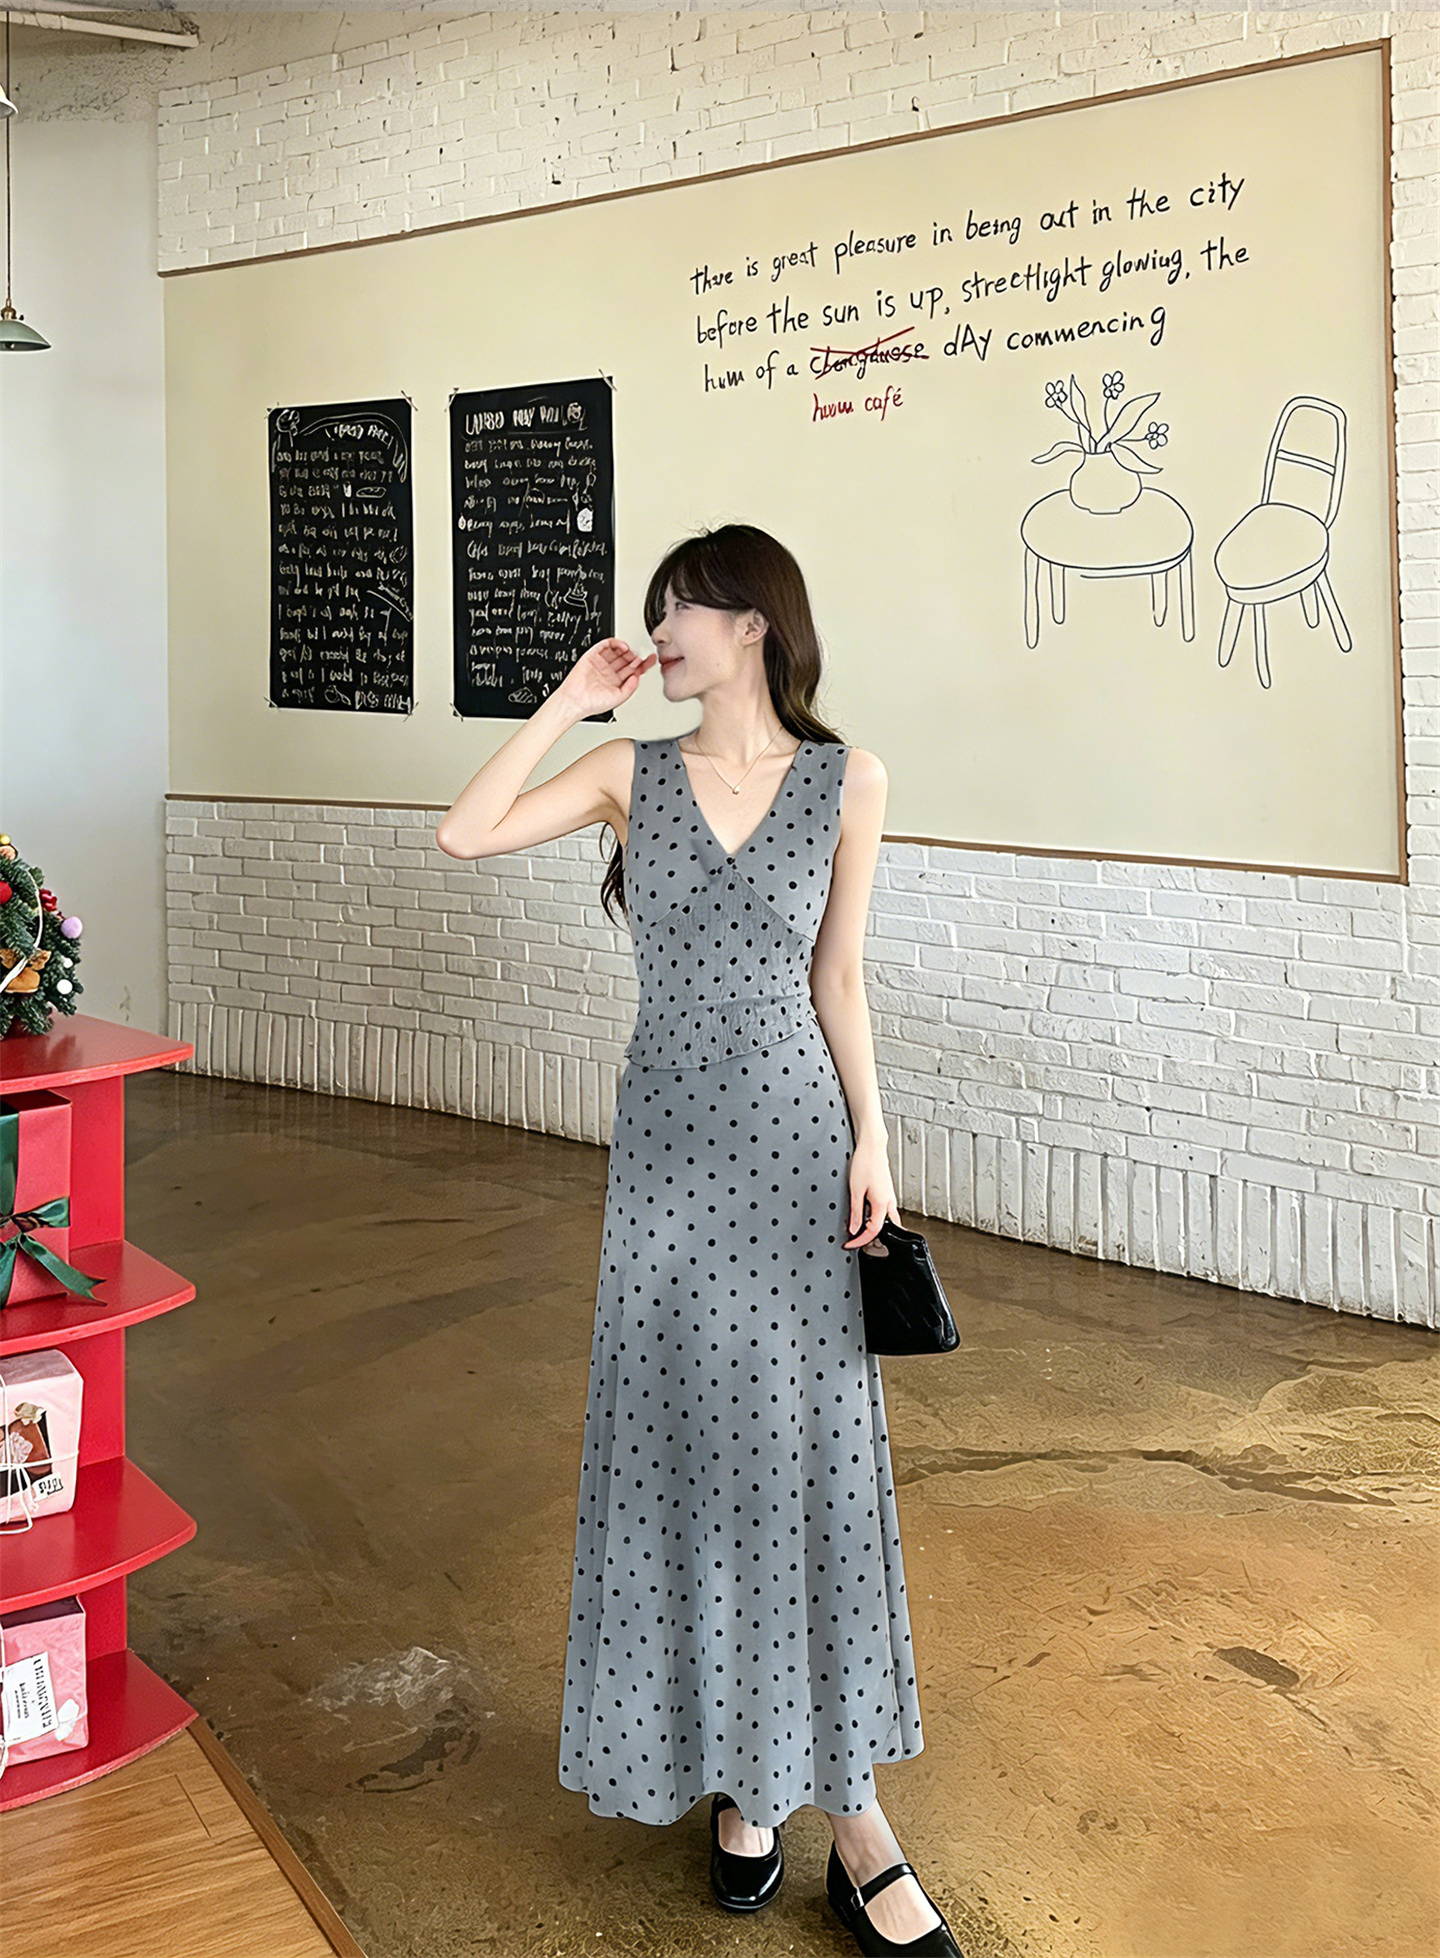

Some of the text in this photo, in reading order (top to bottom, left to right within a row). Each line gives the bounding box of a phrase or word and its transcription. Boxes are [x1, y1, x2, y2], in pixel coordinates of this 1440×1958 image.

[746, 257, 758, 276] is
[771, 242, 818, 282] great
[835, 230, 916, 275] pleasure
[933, 222, 952, 246] in
[966, 210, 1021, 244] being
[1040, 200, 1079, 230] out
[1093, 200, 1112, 224] in
[1126, 188, 1170, 220] the
[1190, 172, 1245, 210] city
[697, 310, 757, 349] before
[766, 296, 809, 334] the
[823, 305, 859, 326] sun
[877, 290, 895, 318] is
[1200, 237, 1249, 270] the
[705, 364, 744, 392] hum
[756, 350, 779, 389] of
[787, 364, 799, 376] a
[1007, 307, 1165, 350] commencing
[865, 385, 903, 421] café
